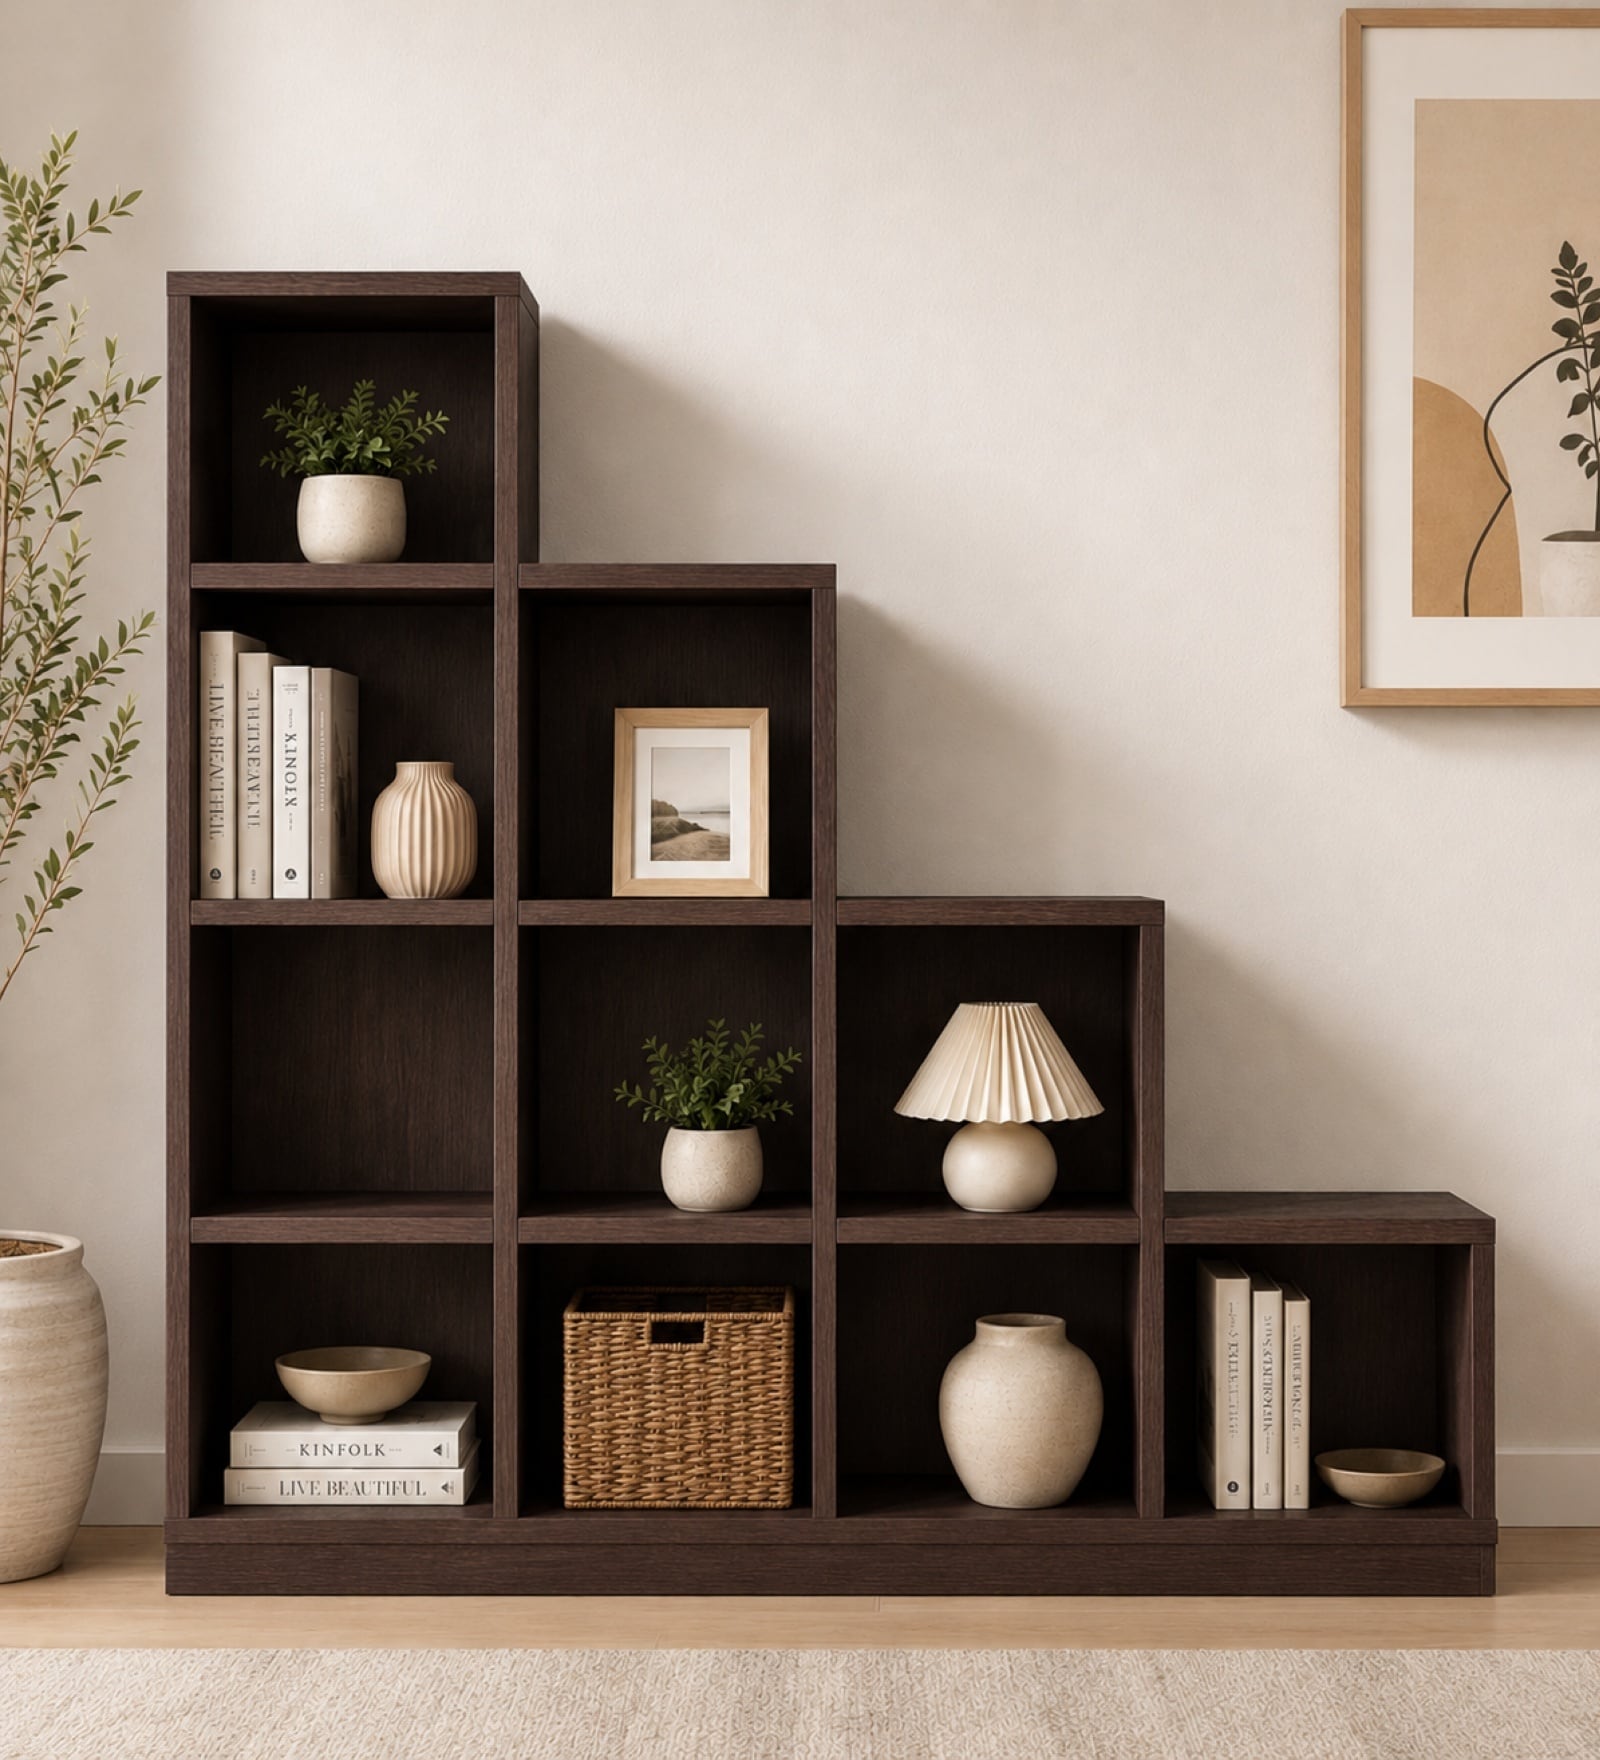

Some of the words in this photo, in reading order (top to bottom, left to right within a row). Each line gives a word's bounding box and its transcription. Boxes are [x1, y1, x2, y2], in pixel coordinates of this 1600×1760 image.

[300, 1443, 386, 1457] KINFOLK
[279, 1480, 321, 1496] LIVE
[327, 1480, 427, 1496] BEAUTIFUL
